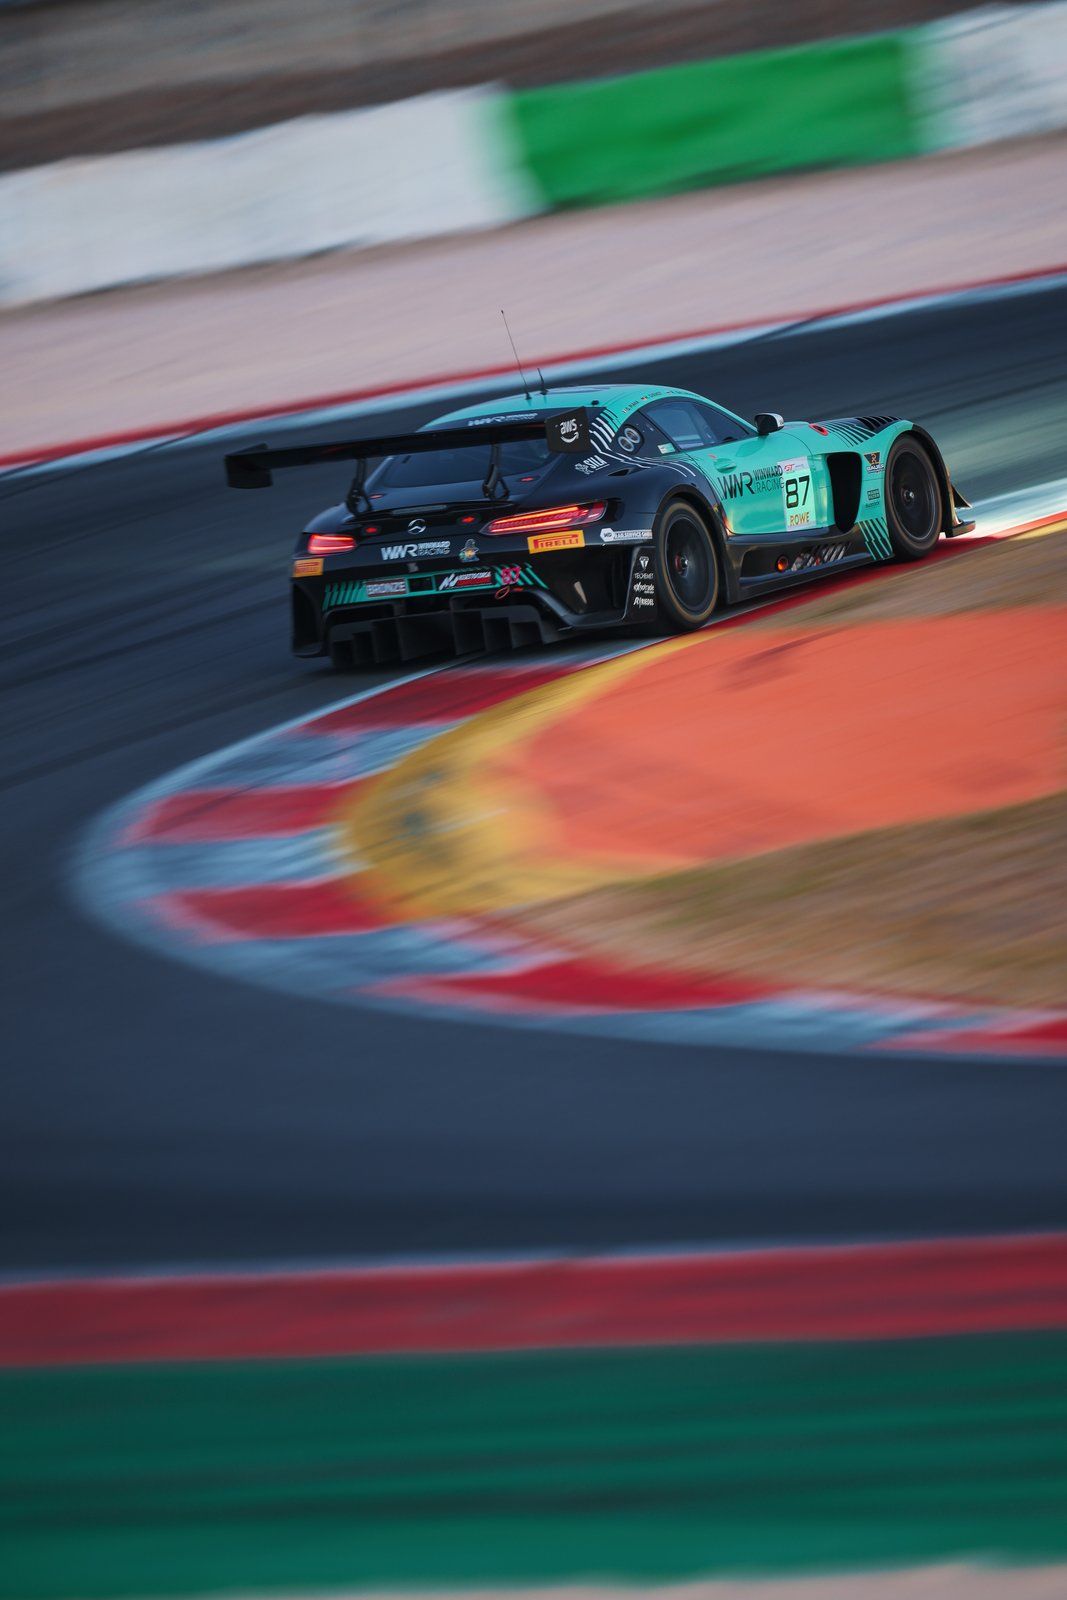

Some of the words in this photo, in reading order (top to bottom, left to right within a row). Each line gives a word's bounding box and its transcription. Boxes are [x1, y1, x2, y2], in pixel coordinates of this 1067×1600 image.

[559, 418, 578, 435] aws
[583, 455, 608, 469] SILA
[753, 465, 783, 481] WINWARD
[756, 477, 785, 493] RACING
[785, 475, 810, 509] 87
[789, 511, 810, 526] ROWE
[533, 533, 579, 549] PIRELLI
